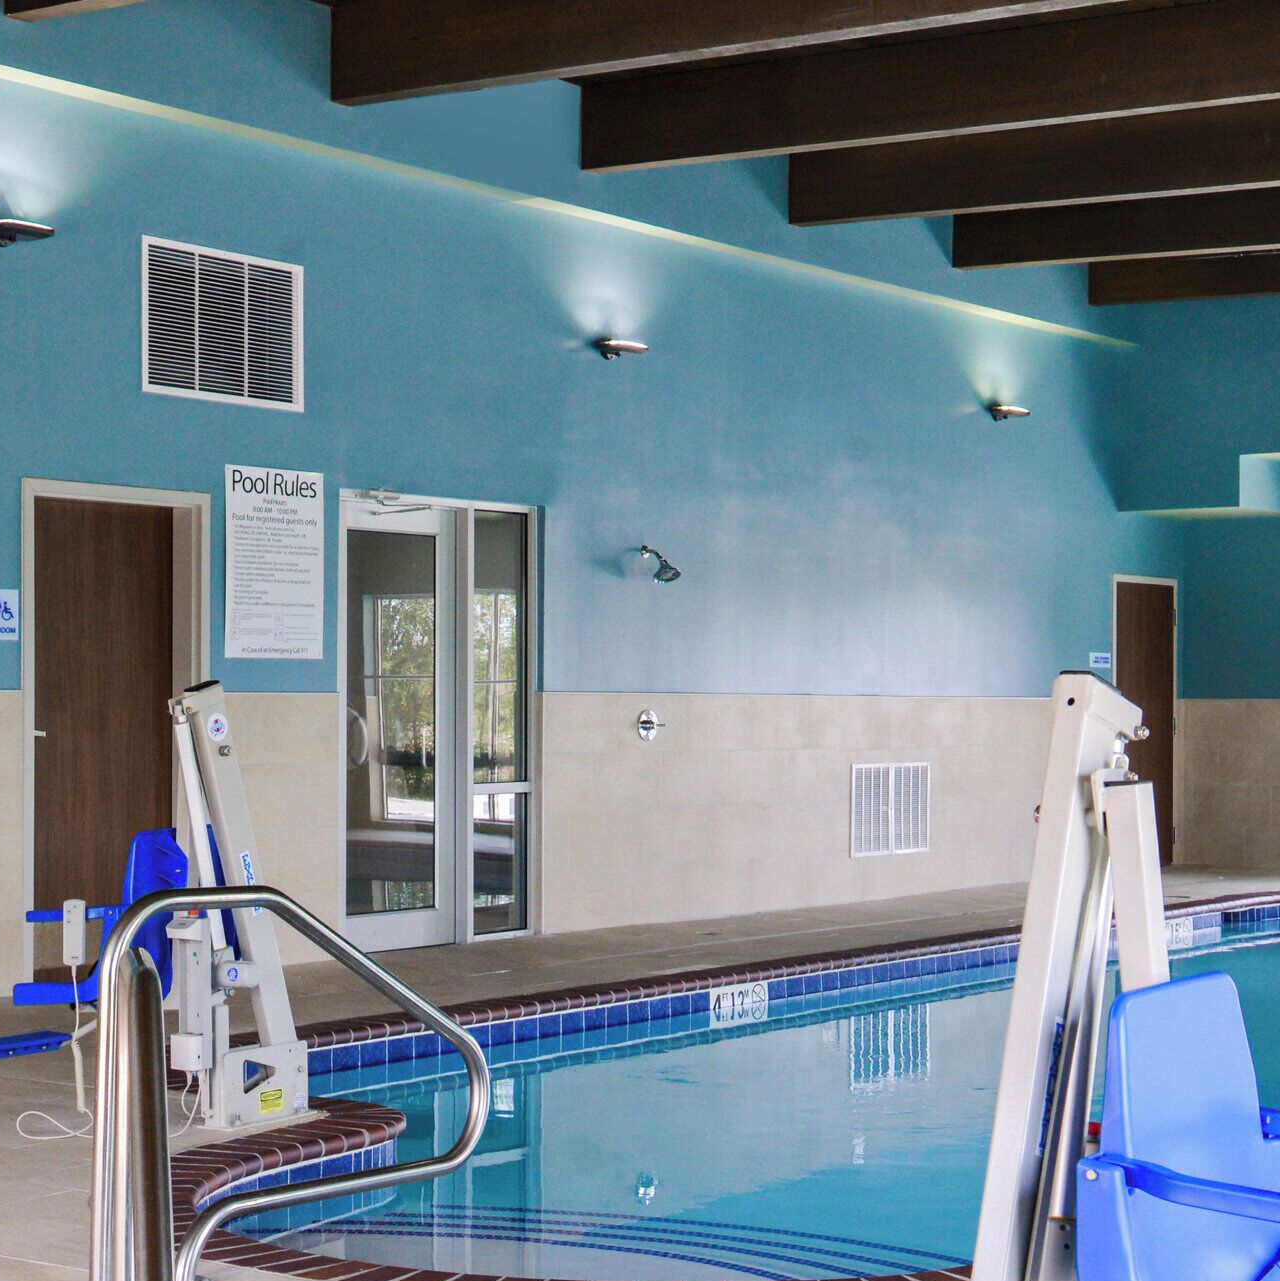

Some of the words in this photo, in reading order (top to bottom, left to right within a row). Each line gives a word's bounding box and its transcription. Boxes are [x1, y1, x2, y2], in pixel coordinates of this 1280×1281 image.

[232, 469, 269, 494] Pool
[274, 473, 317, 499] Rules
[232, 513, 245, 521] Pool
[246, 513, 254, 521] for
[255, 515, 284, 524] registered
[285, 517, 303, 526] guests
[305, 519, 317, 528] only
